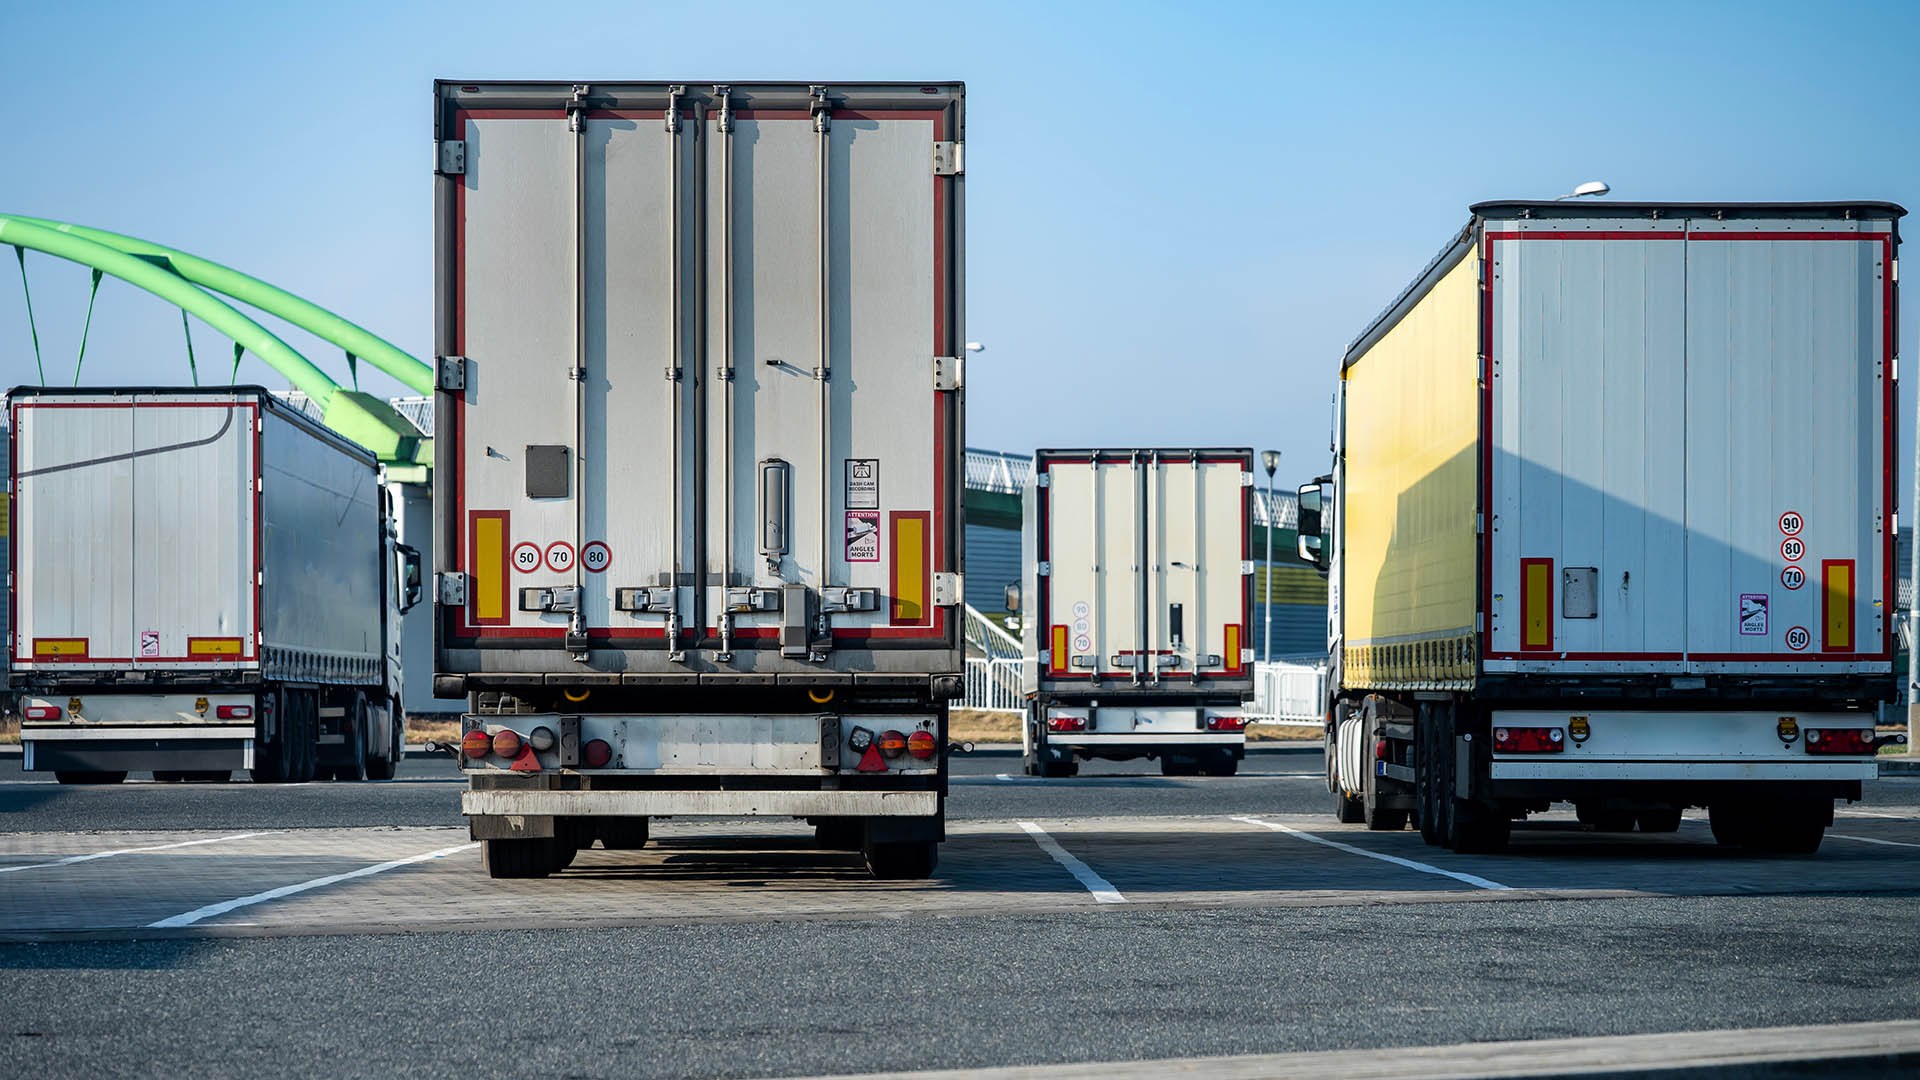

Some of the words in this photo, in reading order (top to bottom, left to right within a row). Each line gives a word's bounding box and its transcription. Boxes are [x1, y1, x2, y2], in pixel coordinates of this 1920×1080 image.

[1783, 517, 1799, 530] 90
[1785, 542, 1801, 555] 80
[519, 552, 534, 563] 50
[553, 552, 568, 563] 70
[589, 551, 604, 562] 80
[1785, 571, 1801, 583] 70
[1076, 606, 1087, 614] 90
[1790, 631, 1806, 644] 60
[1077, 639, 1088, 648] 70
